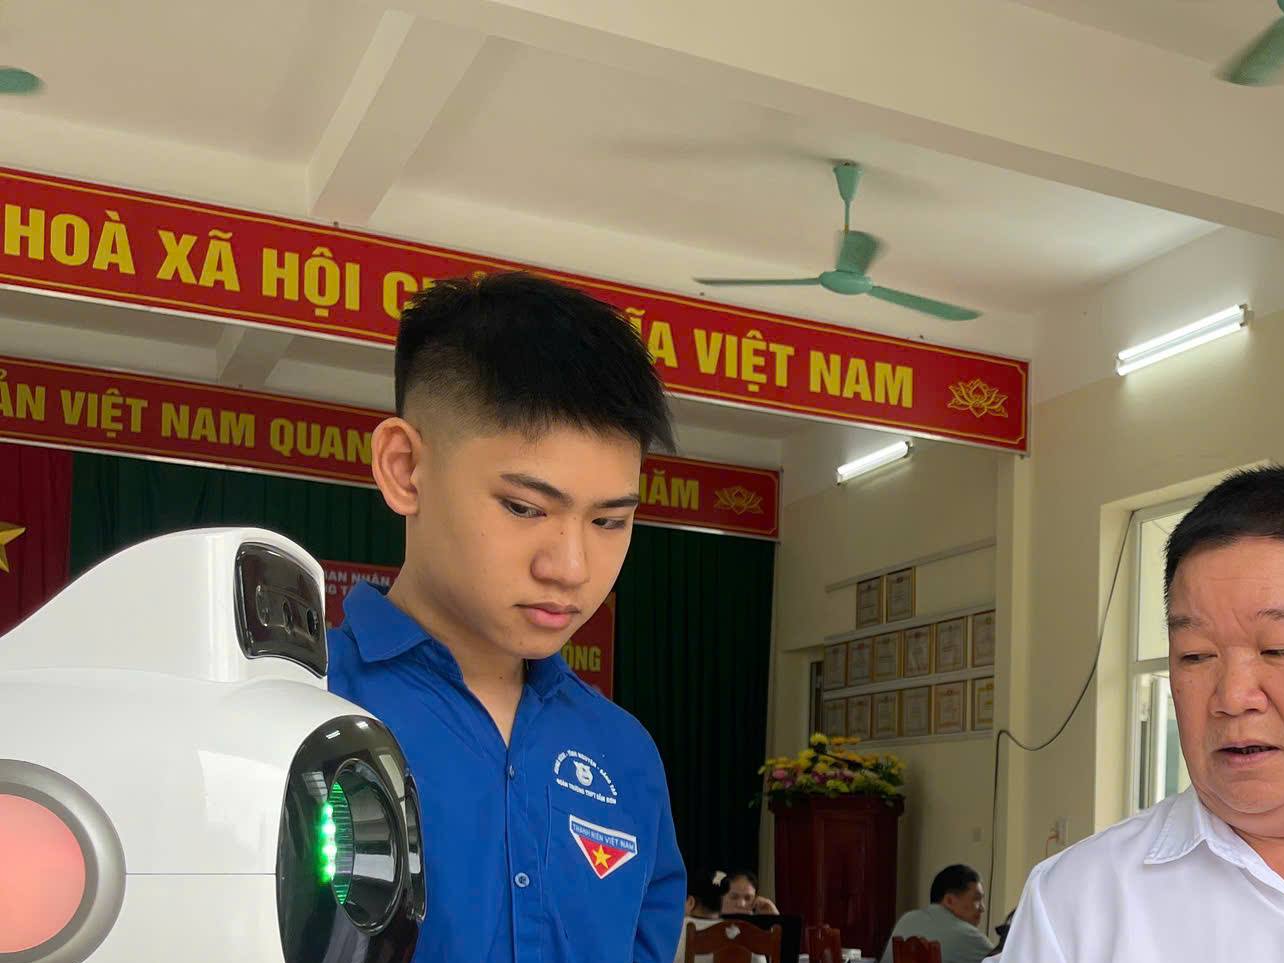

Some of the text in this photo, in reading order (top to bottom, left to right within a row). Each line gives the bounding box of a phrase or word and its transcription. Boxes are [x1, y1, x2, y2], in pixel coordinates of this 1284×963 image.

[4, 203, 136, 275] HOÀ
[157, 229, 241, 292] XÃ
[262, 247, 361, 318] HỘI
[693, 328, 795, 392] VIỆT
[809, 349, 914, 409] NAM
[60, 387, 148, 439] VIỆT
[161, 404, 256, 449] NAM
[270, 417, 373, 466] QUAN
